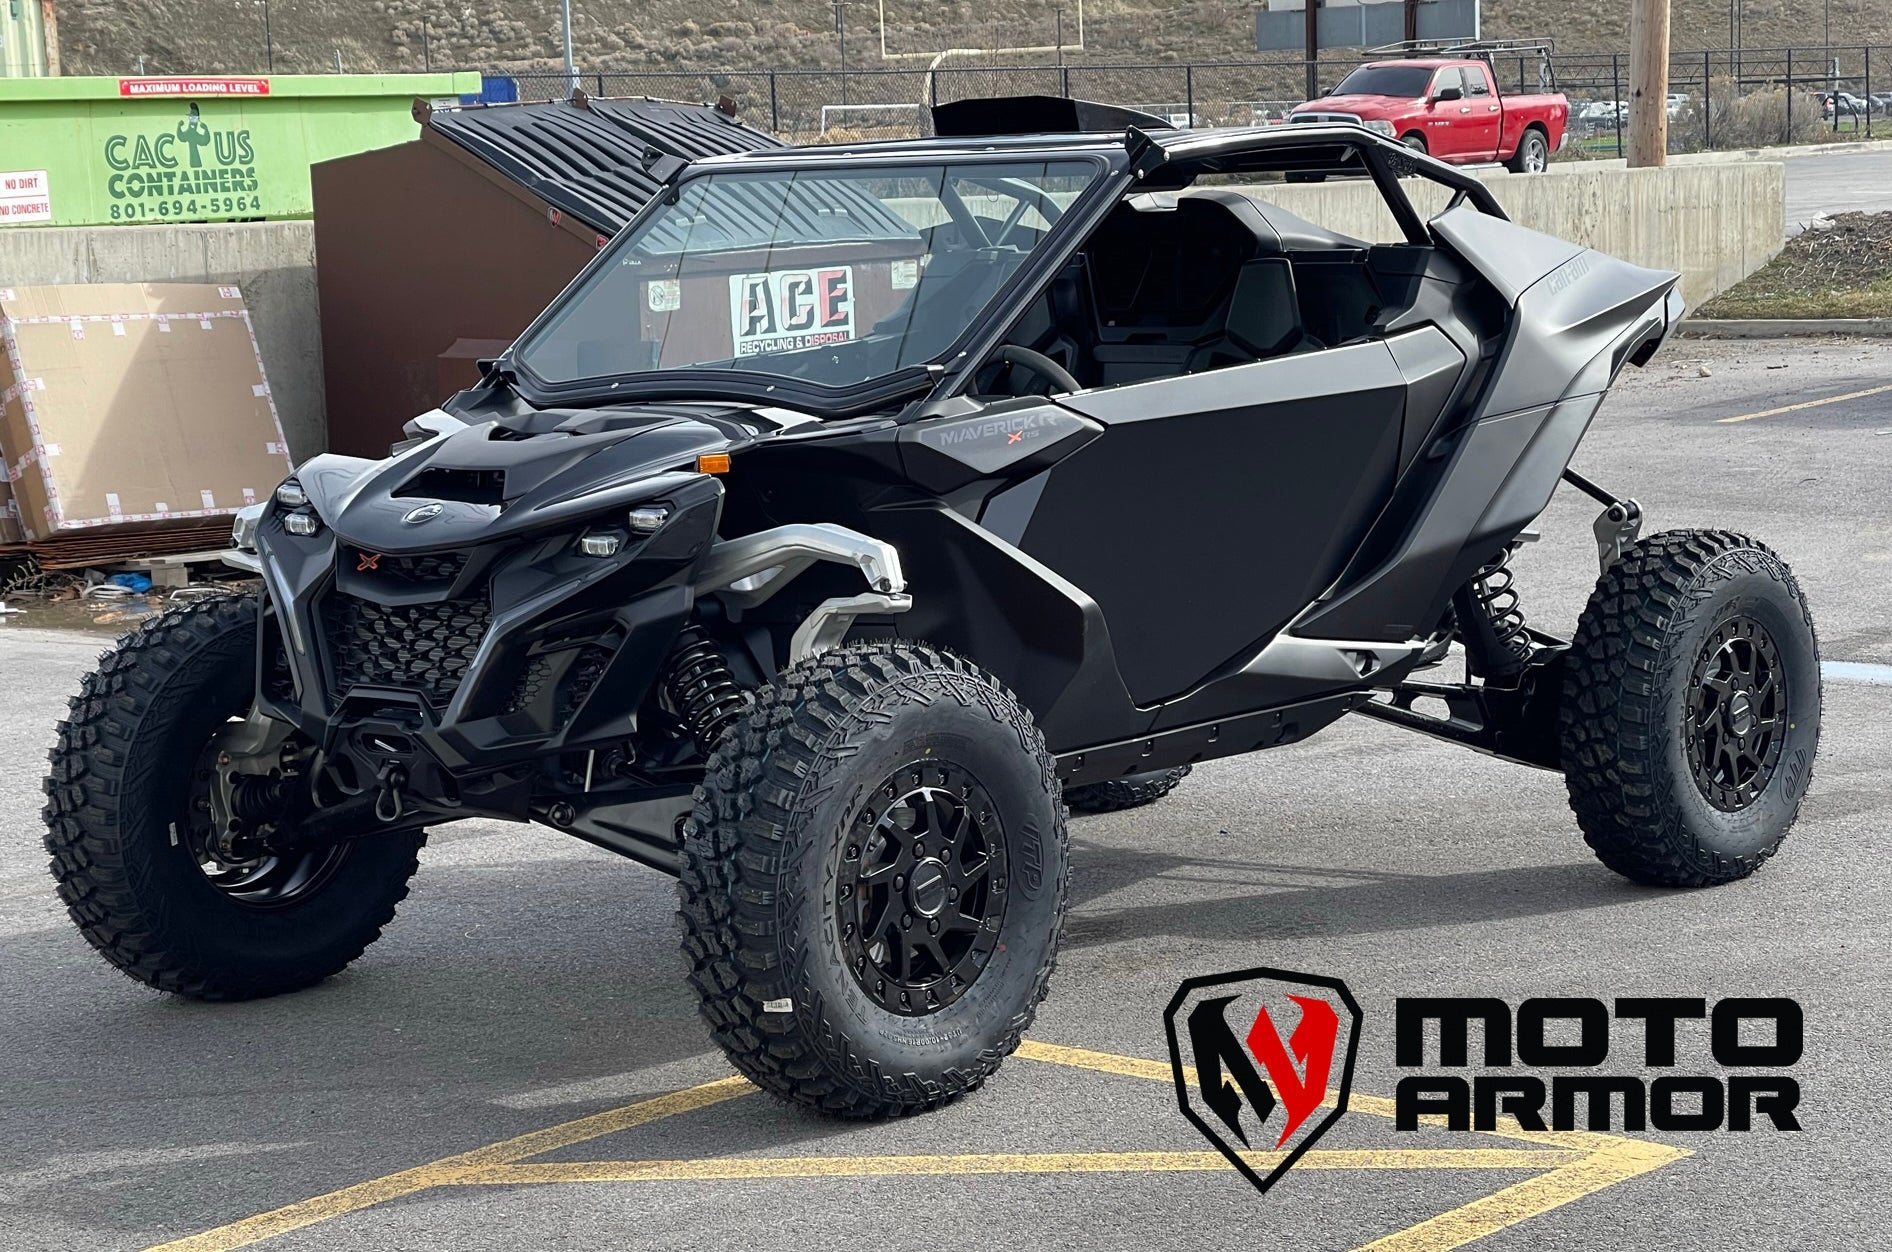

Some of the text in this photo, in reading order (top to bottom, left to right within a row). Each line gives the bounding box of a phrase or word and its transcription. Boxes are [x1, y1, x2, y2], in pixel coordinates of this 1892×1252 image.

[129, 82, 260, 94] MAXIMUM LOADING LEVEL
[104, 122, 255, 172] CACTUS
[5, 177, 38, 190] NO DIRT
[107, 166, 259, 200] CONTAINERS
[0, 202, 49, 216] NO CONCRETE
[109, 195, 261, 220] 801-694-5964
[740, 269, 850, 337] ACE
[740, 339, 794, 355] RECYCLING
[796, 337, 803, 349] &
[939, 415, 1038, 447] MAVERICK
